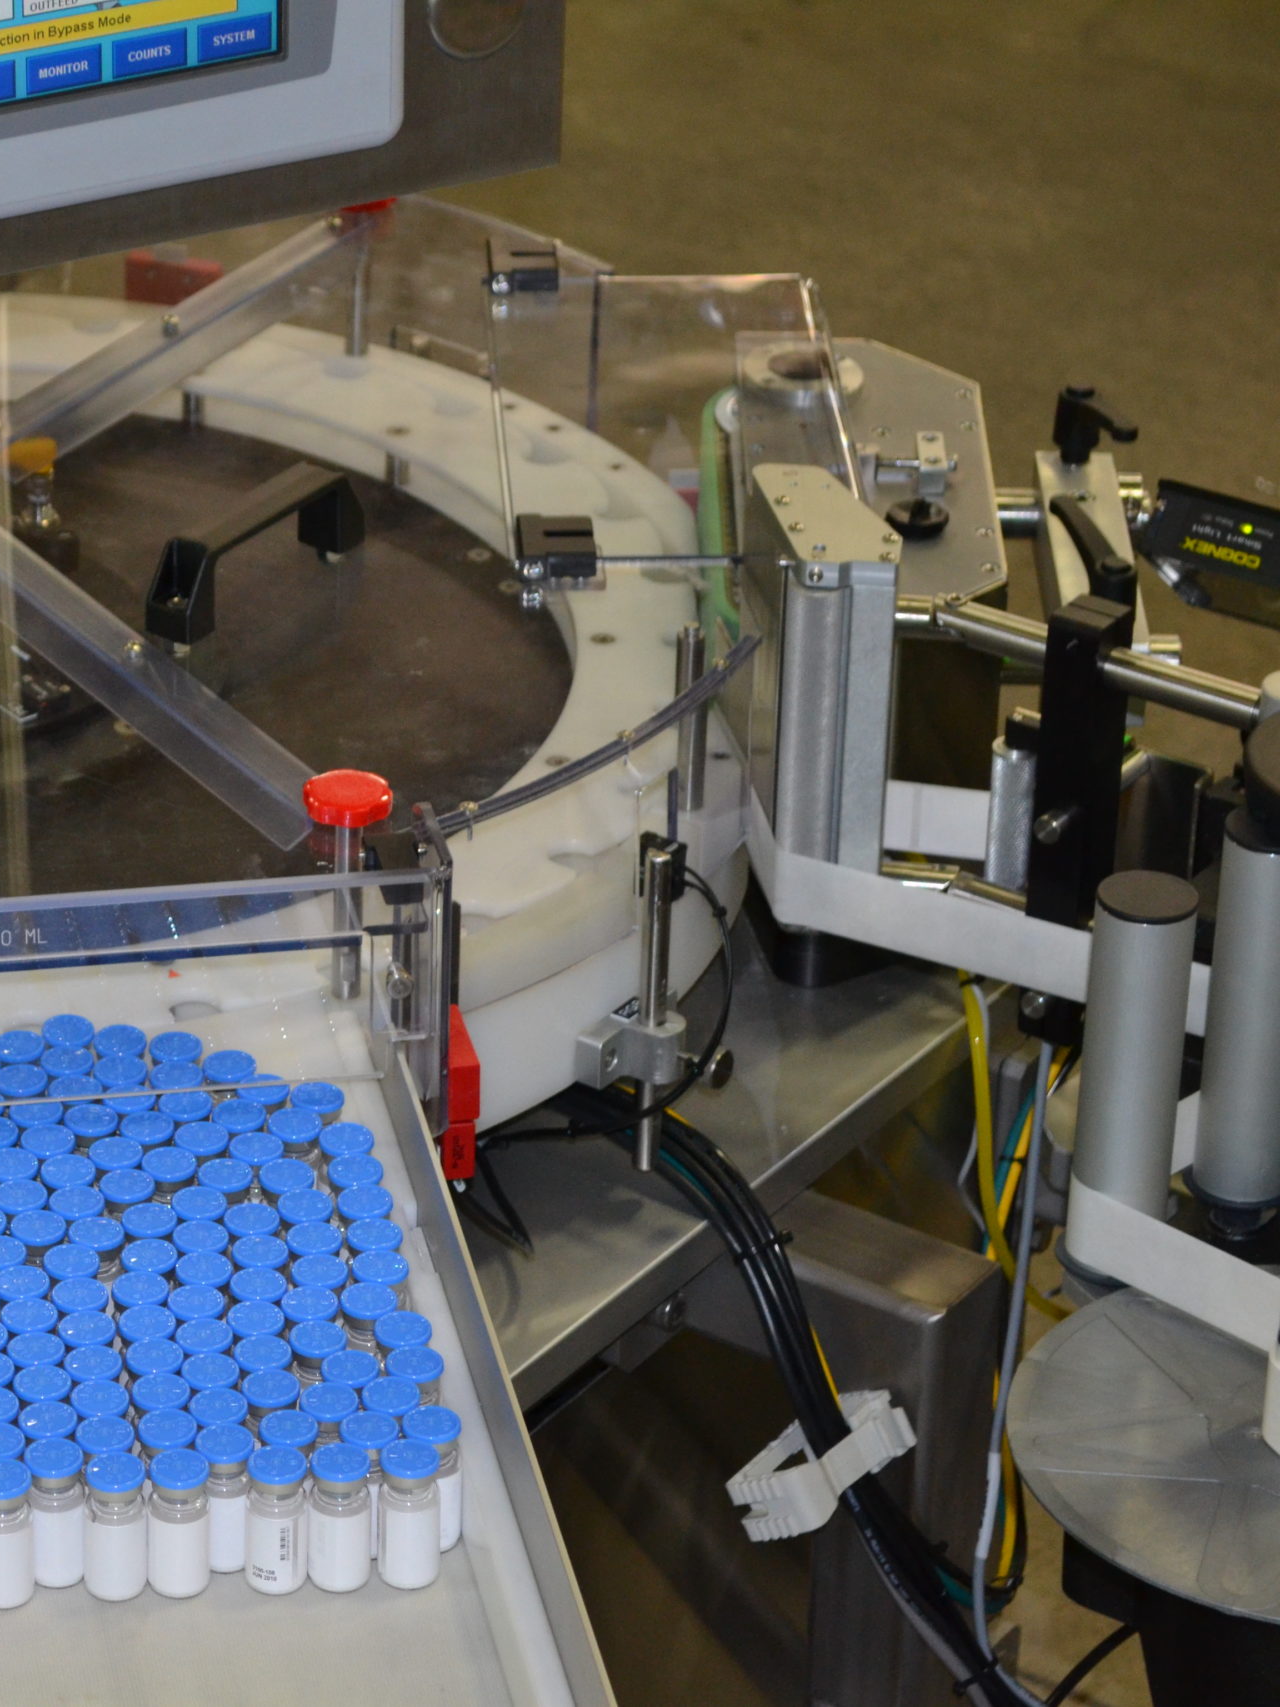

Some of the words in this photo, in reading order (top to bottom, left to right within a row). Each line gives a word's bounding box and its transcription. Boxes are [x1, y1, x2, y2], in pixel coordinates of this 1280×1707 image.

[33, 29, 45, 41] in
[48, 22, 94, 40] Bypass
[98, 14, 131, 29] Mode
[213, 29, 255, 46] SYSTEM
[128, 45, 171, 62] COUNTS
[39, 60, 88, 79] MONITOR
[1192, 523, 1221, 538] Light
[1227, 533, 1261, 550] Smart
[1182, 536, 1261, 569] COGNEX
[25, 928, 48, 945] ML
